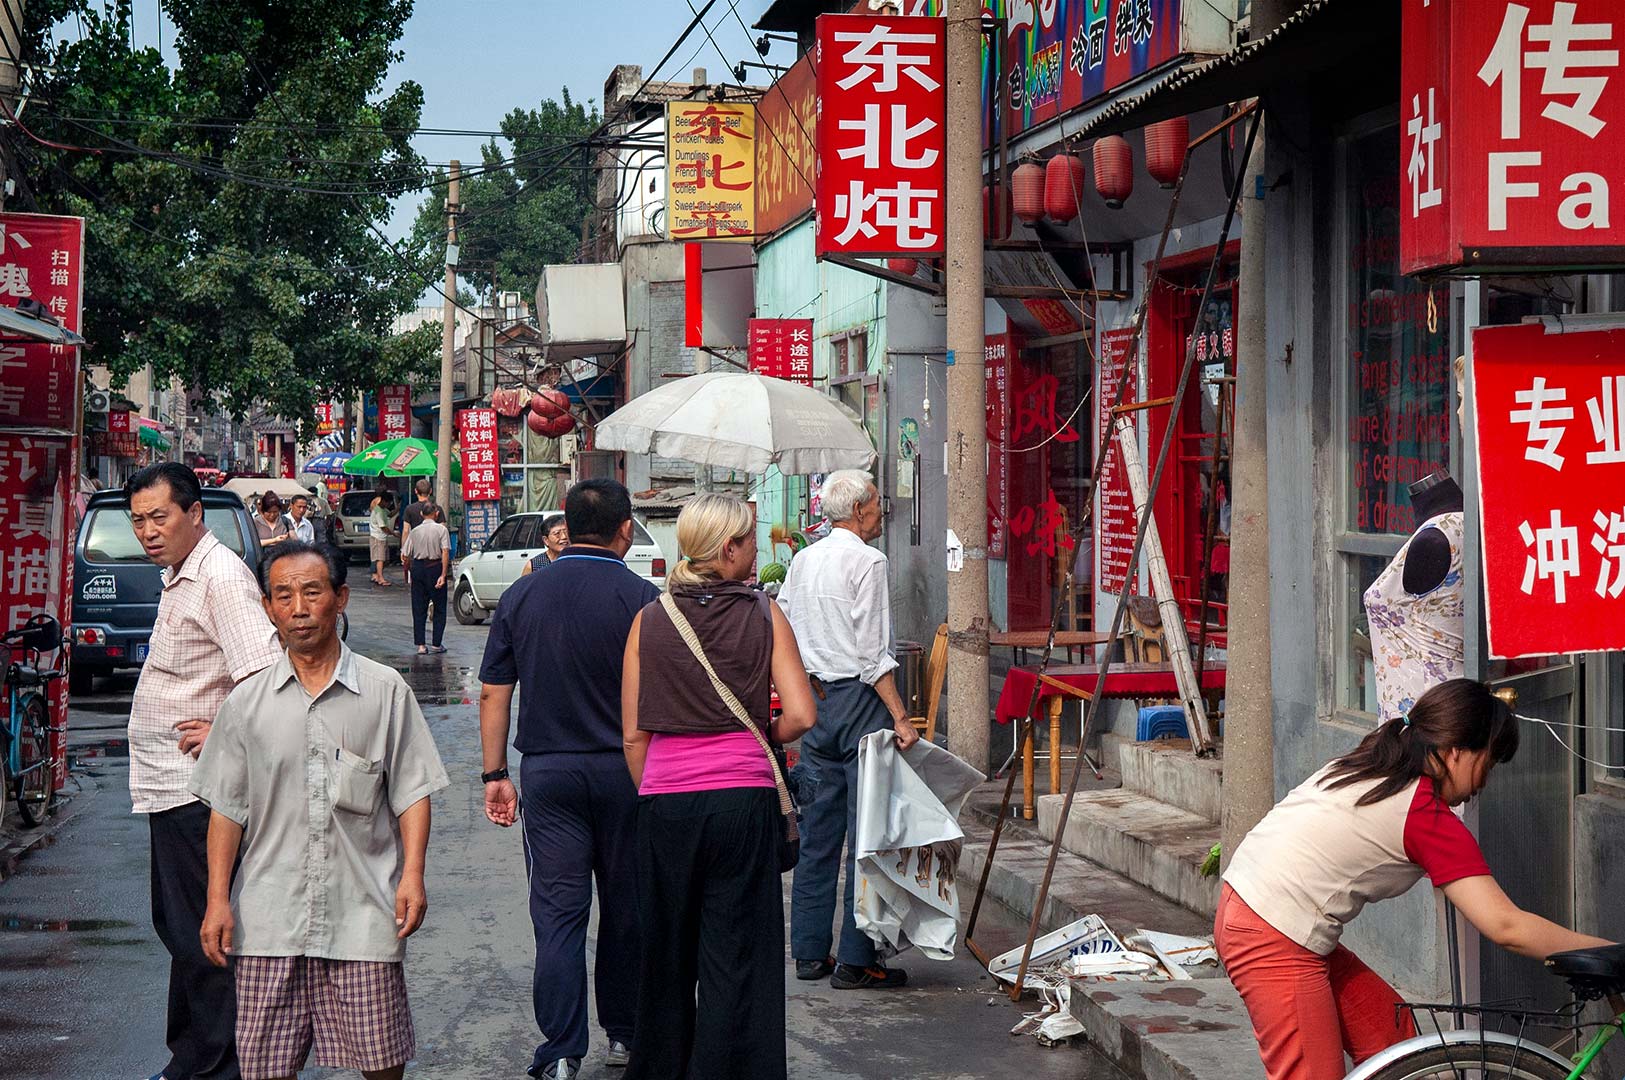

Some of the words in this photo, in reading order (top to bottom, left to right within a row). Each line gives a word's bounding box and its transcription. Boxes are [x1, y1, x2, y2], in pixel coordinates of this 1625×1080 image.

[1070, 16, 1107, 77] 冷面
[1477, 1, 1619, 139] 传
[675, 116, 691, 127] Beer
[725, 117, 741, 128] Beef
[675, 133, 702, 144] Chicken
[833, 25, 941, 248] 东北炖
[671, 104, 752, 237] 东北菜
[675, 150, 710, 163] Dumplings
[675, 166, 697, 177] French
[1407, 88, 1442, 218] 社
[675, 182, 697, 194] Coffee
[675, 200, 695, 211] Sweet
[699, 201, 711, 211] and
[1488, 151, 1611, 231] Fa
[675, 217, 706, 228] Tomatoes
[733, 219, 748, 229] soup
[51, 249, 69, 286] 扫描
[466, 429, 493, 442] 饮料
[467, 411, 491, 428] 香烟
[1509, 377, 1625, 472] 专业
[0, 437, 66, 482] 订
[467, 449, 494, 462] 百货
[1354, 448, 1369, 488] of
[1374, 449, 1446, 484] ceremon
[468, 470, 495, 483] 食品
[468, 489, 480, 498] IP
[484, 488, 496, 498] 卡
[0, 494, 53, 540] 真
[1357, 488, 1369, 529] al
[1374, 489, 1415, 534] dress
[0, 546, 50, 596] 描
